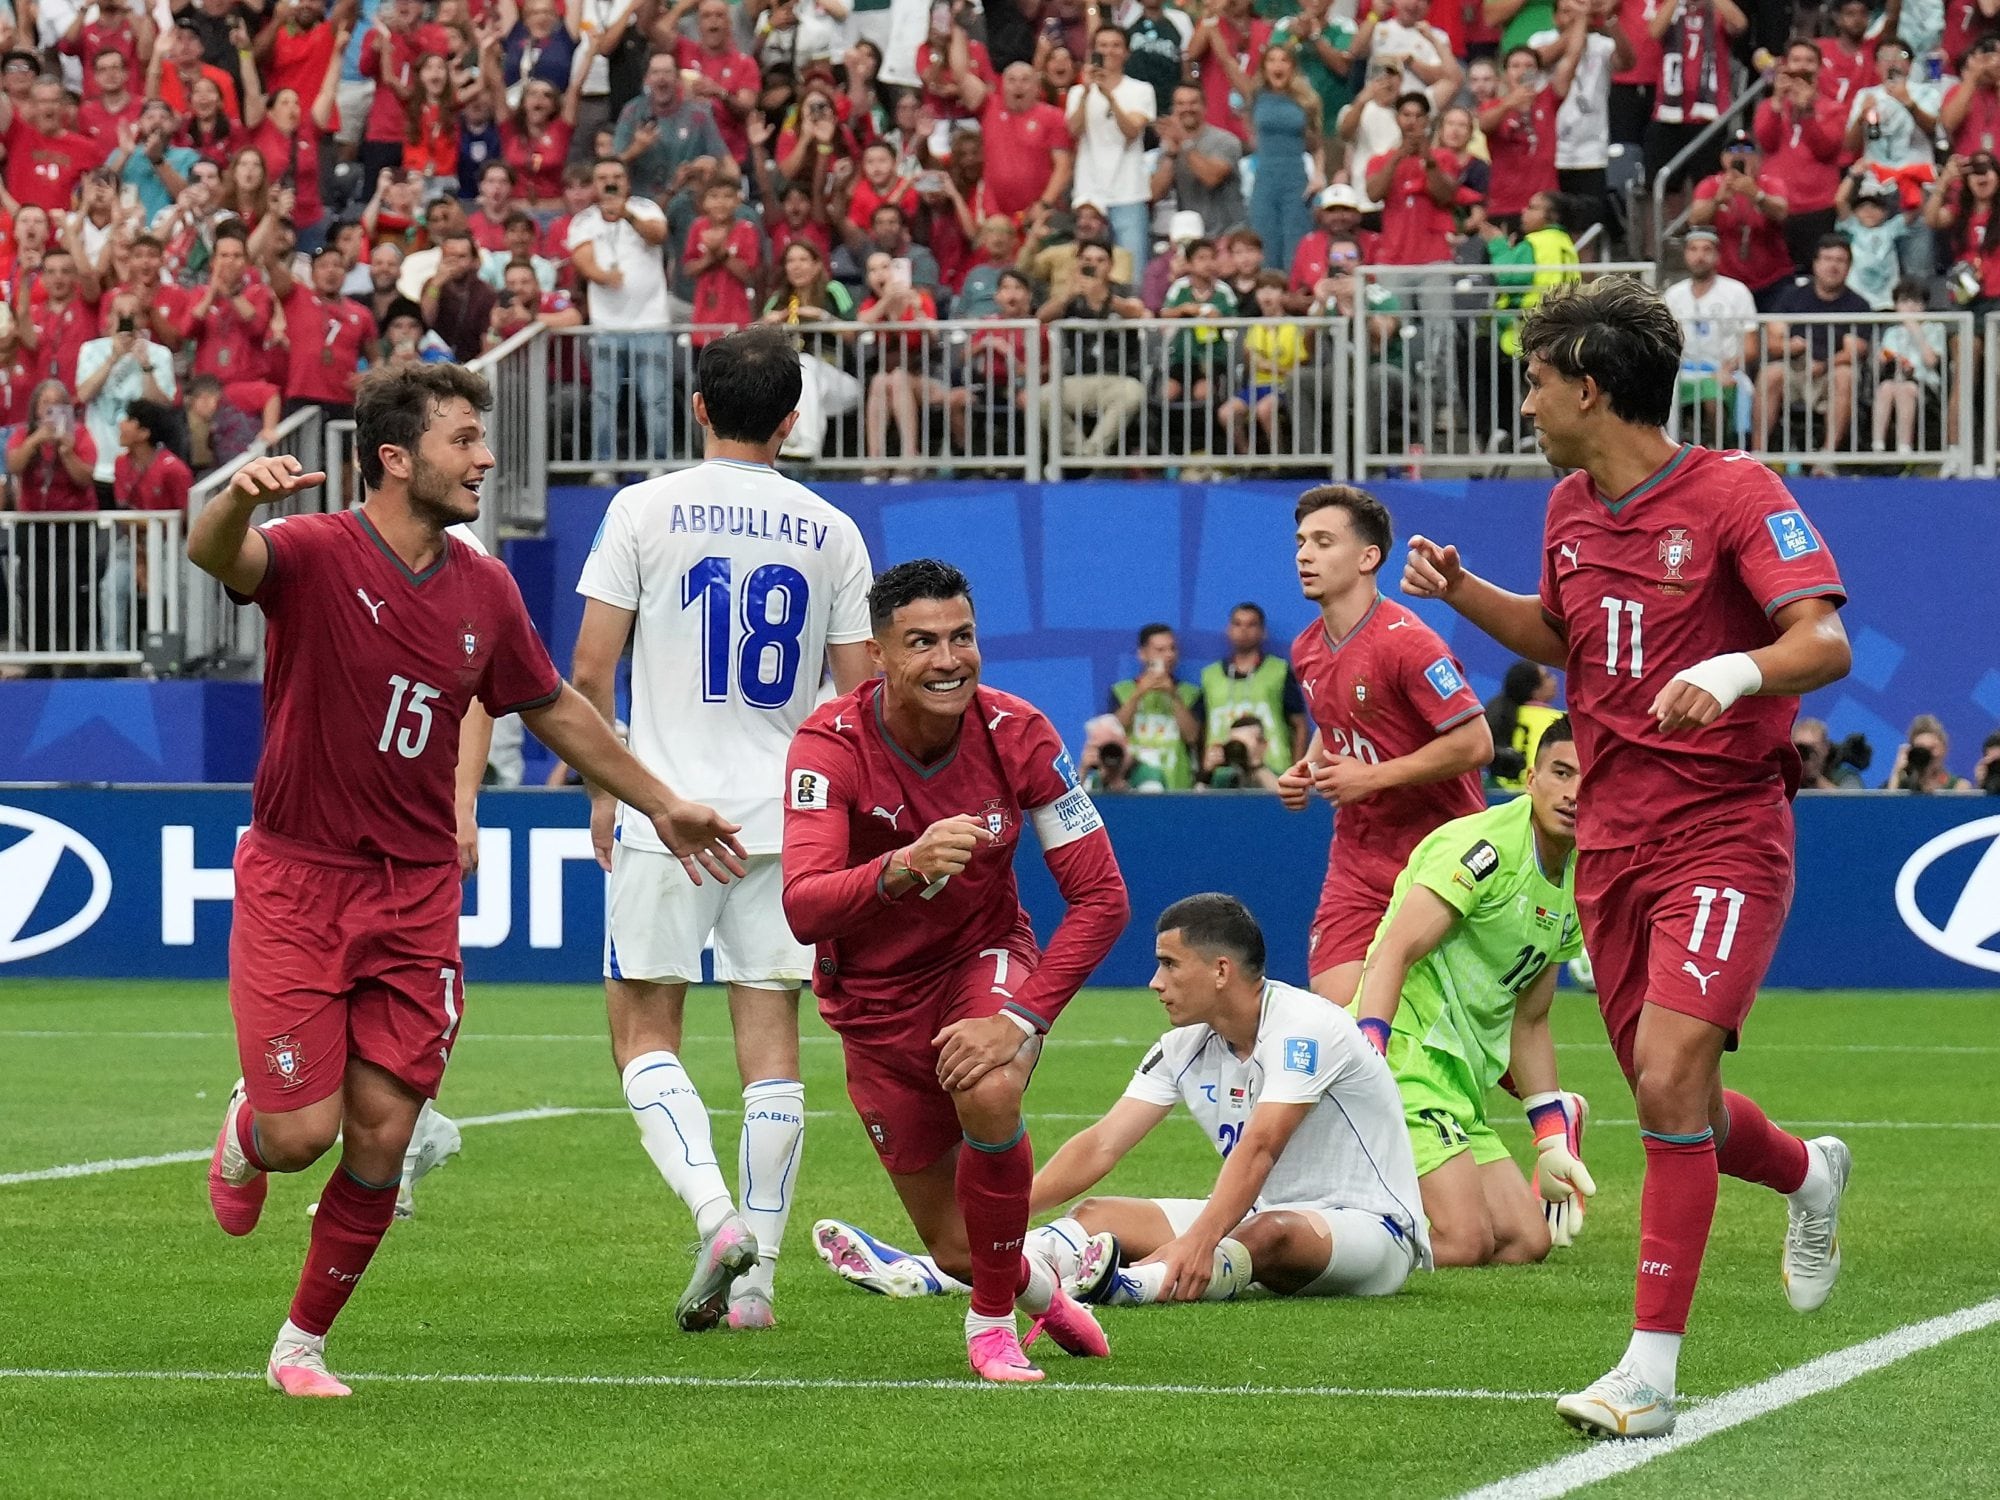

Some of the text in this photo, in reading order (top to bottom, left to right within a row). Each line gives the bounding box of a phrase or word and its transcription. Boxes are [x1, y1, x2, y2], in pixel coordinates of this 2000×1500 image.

[325, 318, 343, 346] 7
[669, 504, 828, 551] ABDULLAEV
[681, 556, 810, 710] 18
[1600, 596, 1644, 678] 11
[378, 674, 442, 759] 15
[1687, 886, 1746, 962] 11
[979, 948, 1010, 985] 7
[1498, 944, 1547, 997] 12
[440, 967, 465, 1040] 1
[747, 1111, 800, 1125] SABER
